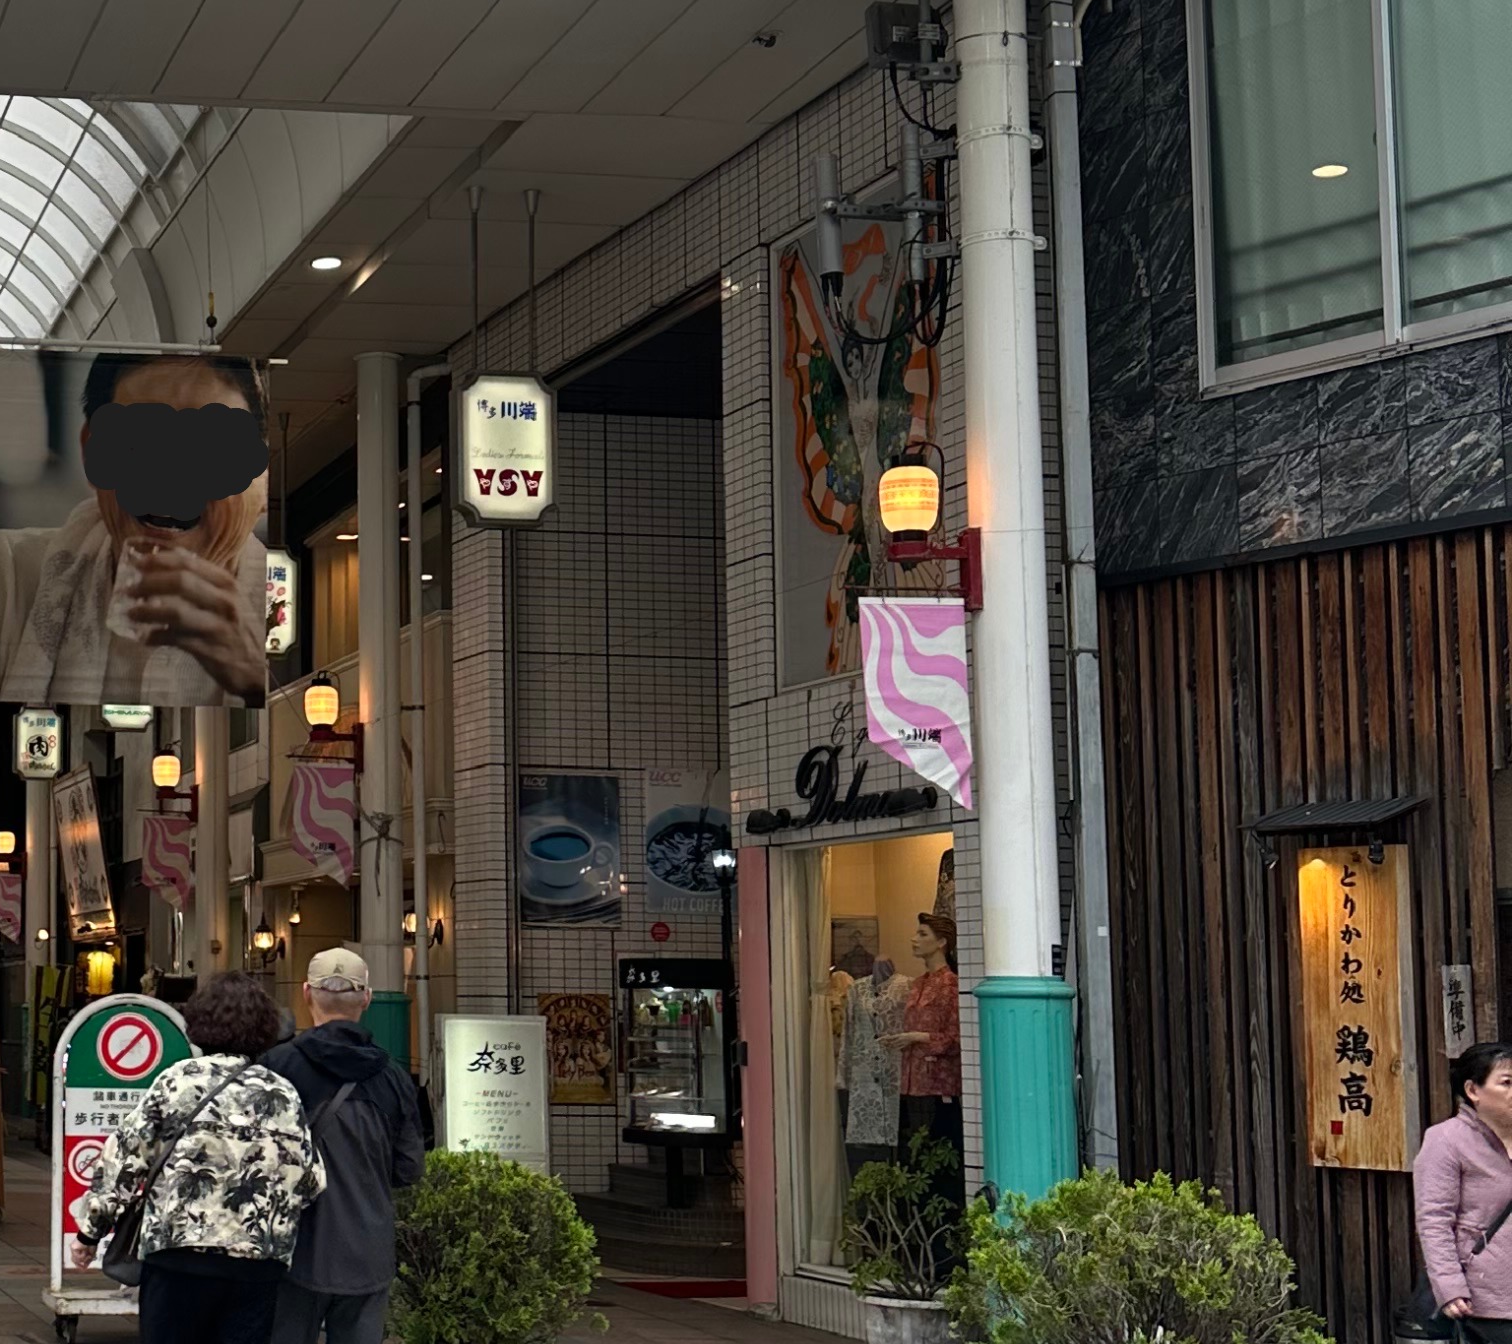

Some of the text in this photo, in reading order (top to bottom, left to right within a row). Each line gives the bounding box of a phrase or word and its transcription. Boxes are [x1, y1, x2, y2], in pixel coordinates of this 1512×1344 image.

[477, 398, 538, 422] 博多川端
[473, 468, 545, 498] YSY
[662, 897, 724, 913] HOT COFFE
[1334, 865, 1374, 1117] とりかわ処 鶏高
[1446, 978, 1467, 1041] 準備中
